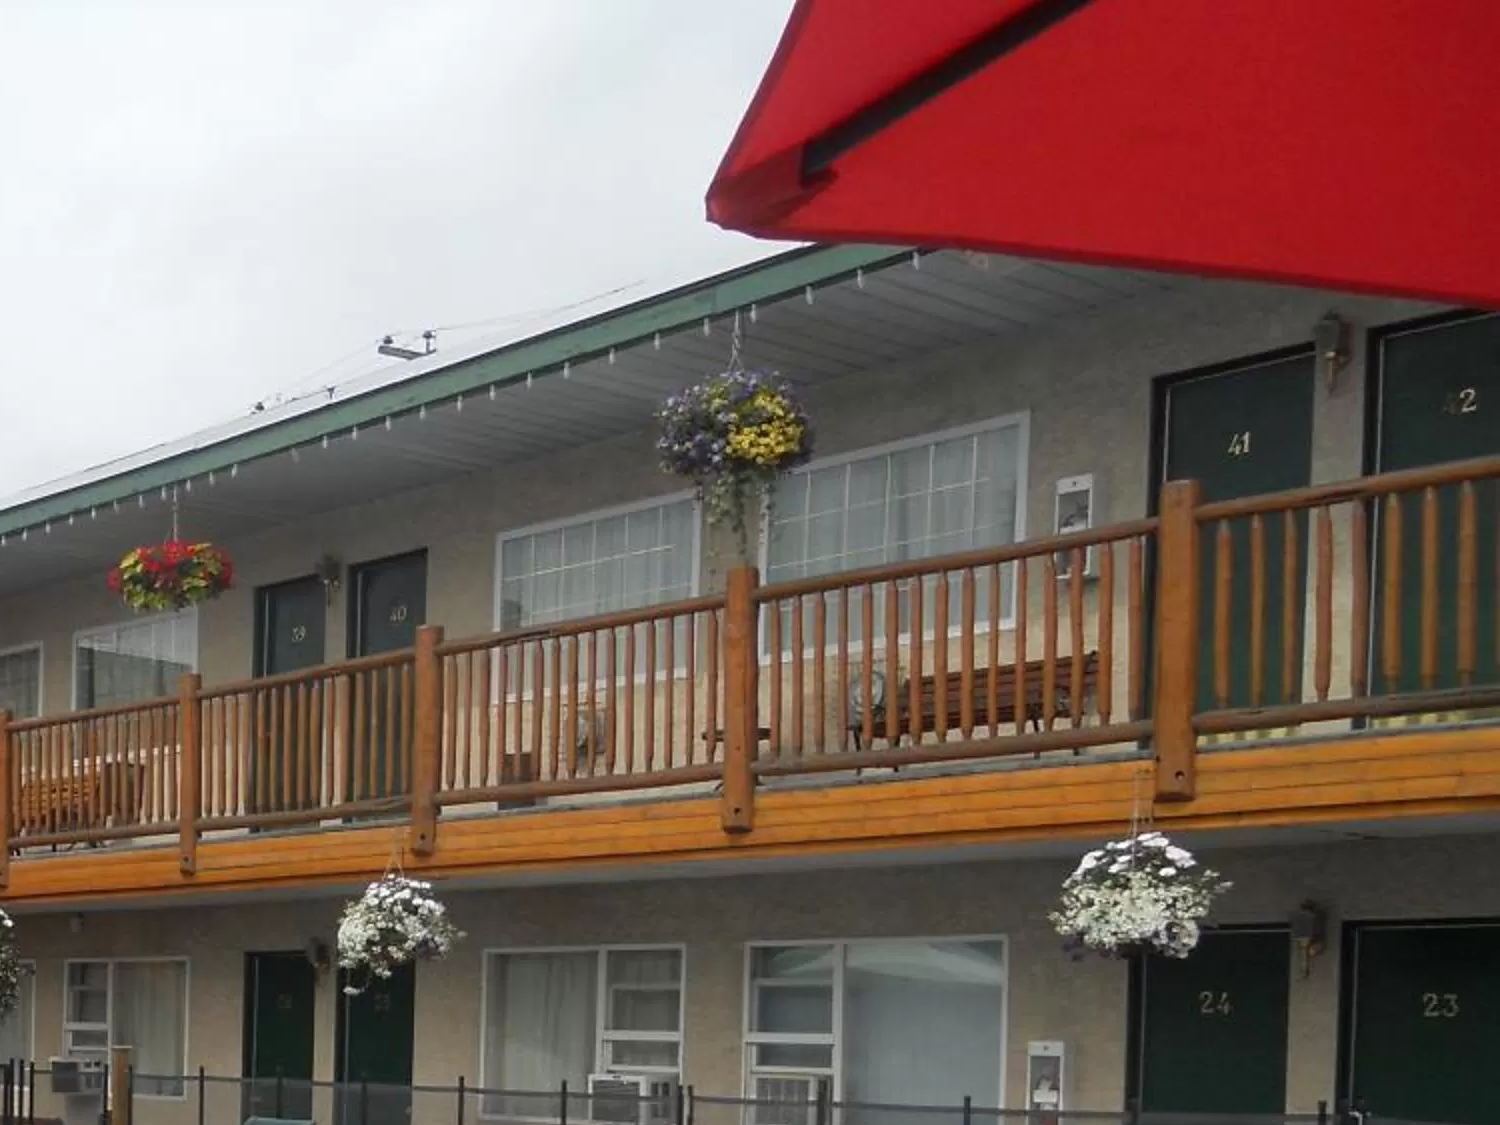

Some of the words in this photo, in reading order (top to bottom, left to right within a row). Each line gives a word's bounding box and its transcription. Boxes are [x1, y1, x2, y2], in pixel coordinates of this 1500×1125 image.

[1228, 431, 1250, 455] 41
[1199, 990, 1232, 1015] 24
[1422, 993, 1460, 1017] 23
